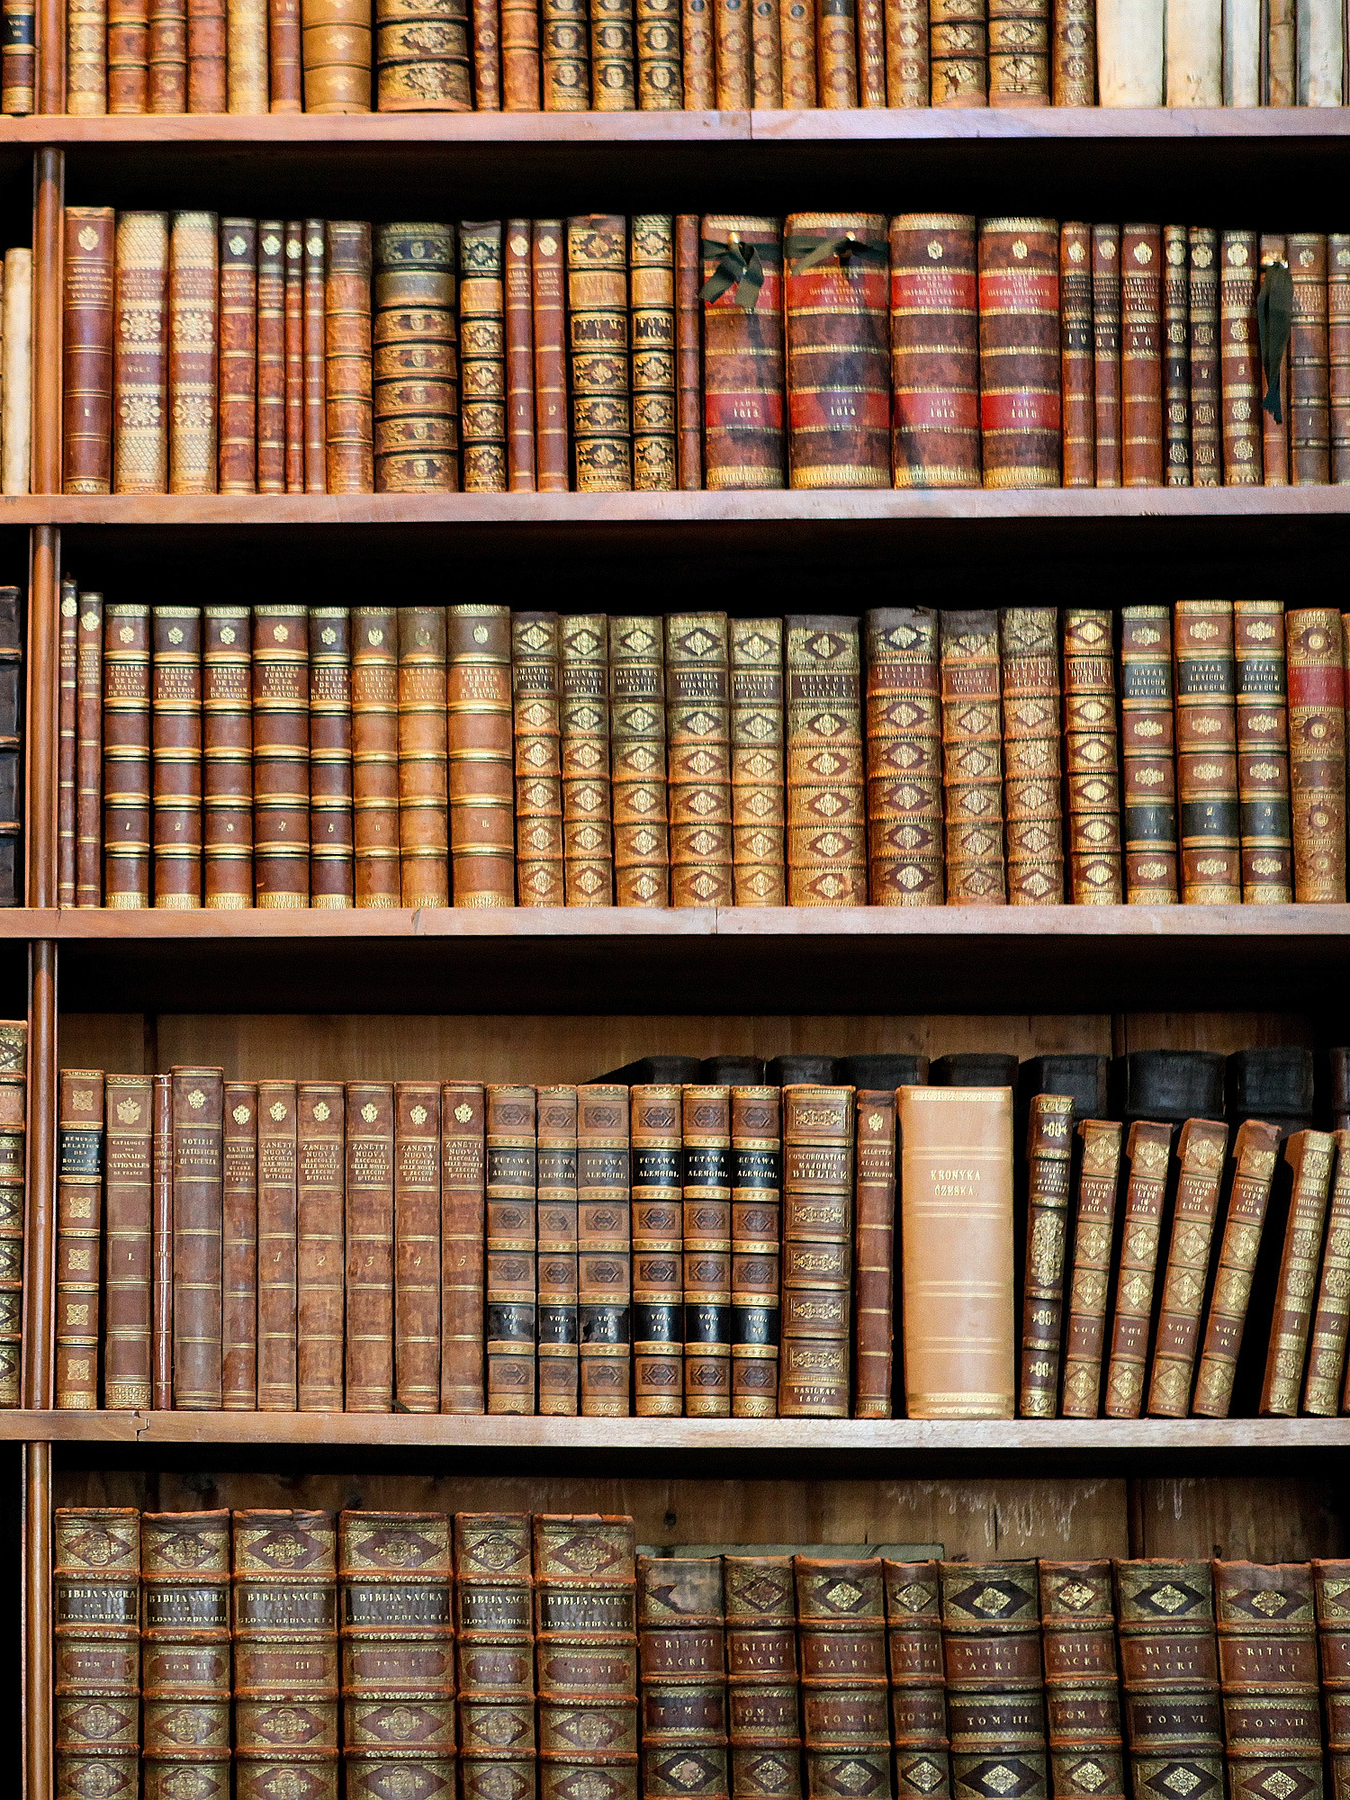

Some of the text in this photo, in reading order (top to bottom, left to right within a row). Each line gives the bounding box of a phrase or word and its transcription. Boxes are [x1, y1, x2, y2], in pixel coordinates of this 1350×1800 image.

[352, 1143, 388, 1151] ZANETTI
[446, 1141, 482, 1149] ZANETTI
[930, 1169, 982, 1182] KRONYKA
[317, 1255, 326, 1267] 2
[365, 1256, 375, 1268] 3
[414, 1256, 422, 1267] 4
[458, 1255, 467, 1267] 5
[59, 1589, 98, 1600] BIBLIA
[248, 1591, 327, 1602] BIBLIA SACRA
[359, 1592, 444, 1603] BIBLIA SACRA
[464, 1595, 503, 1605] BIBLIA
[547, 1596, 628, 1606] BIBLIA SACRA
[954, 1646, 1020, 1657] CRITICI
[957, 1661, 1013, 1672] SACRI
[1141, 1661, 1194, 1672] SACRI
